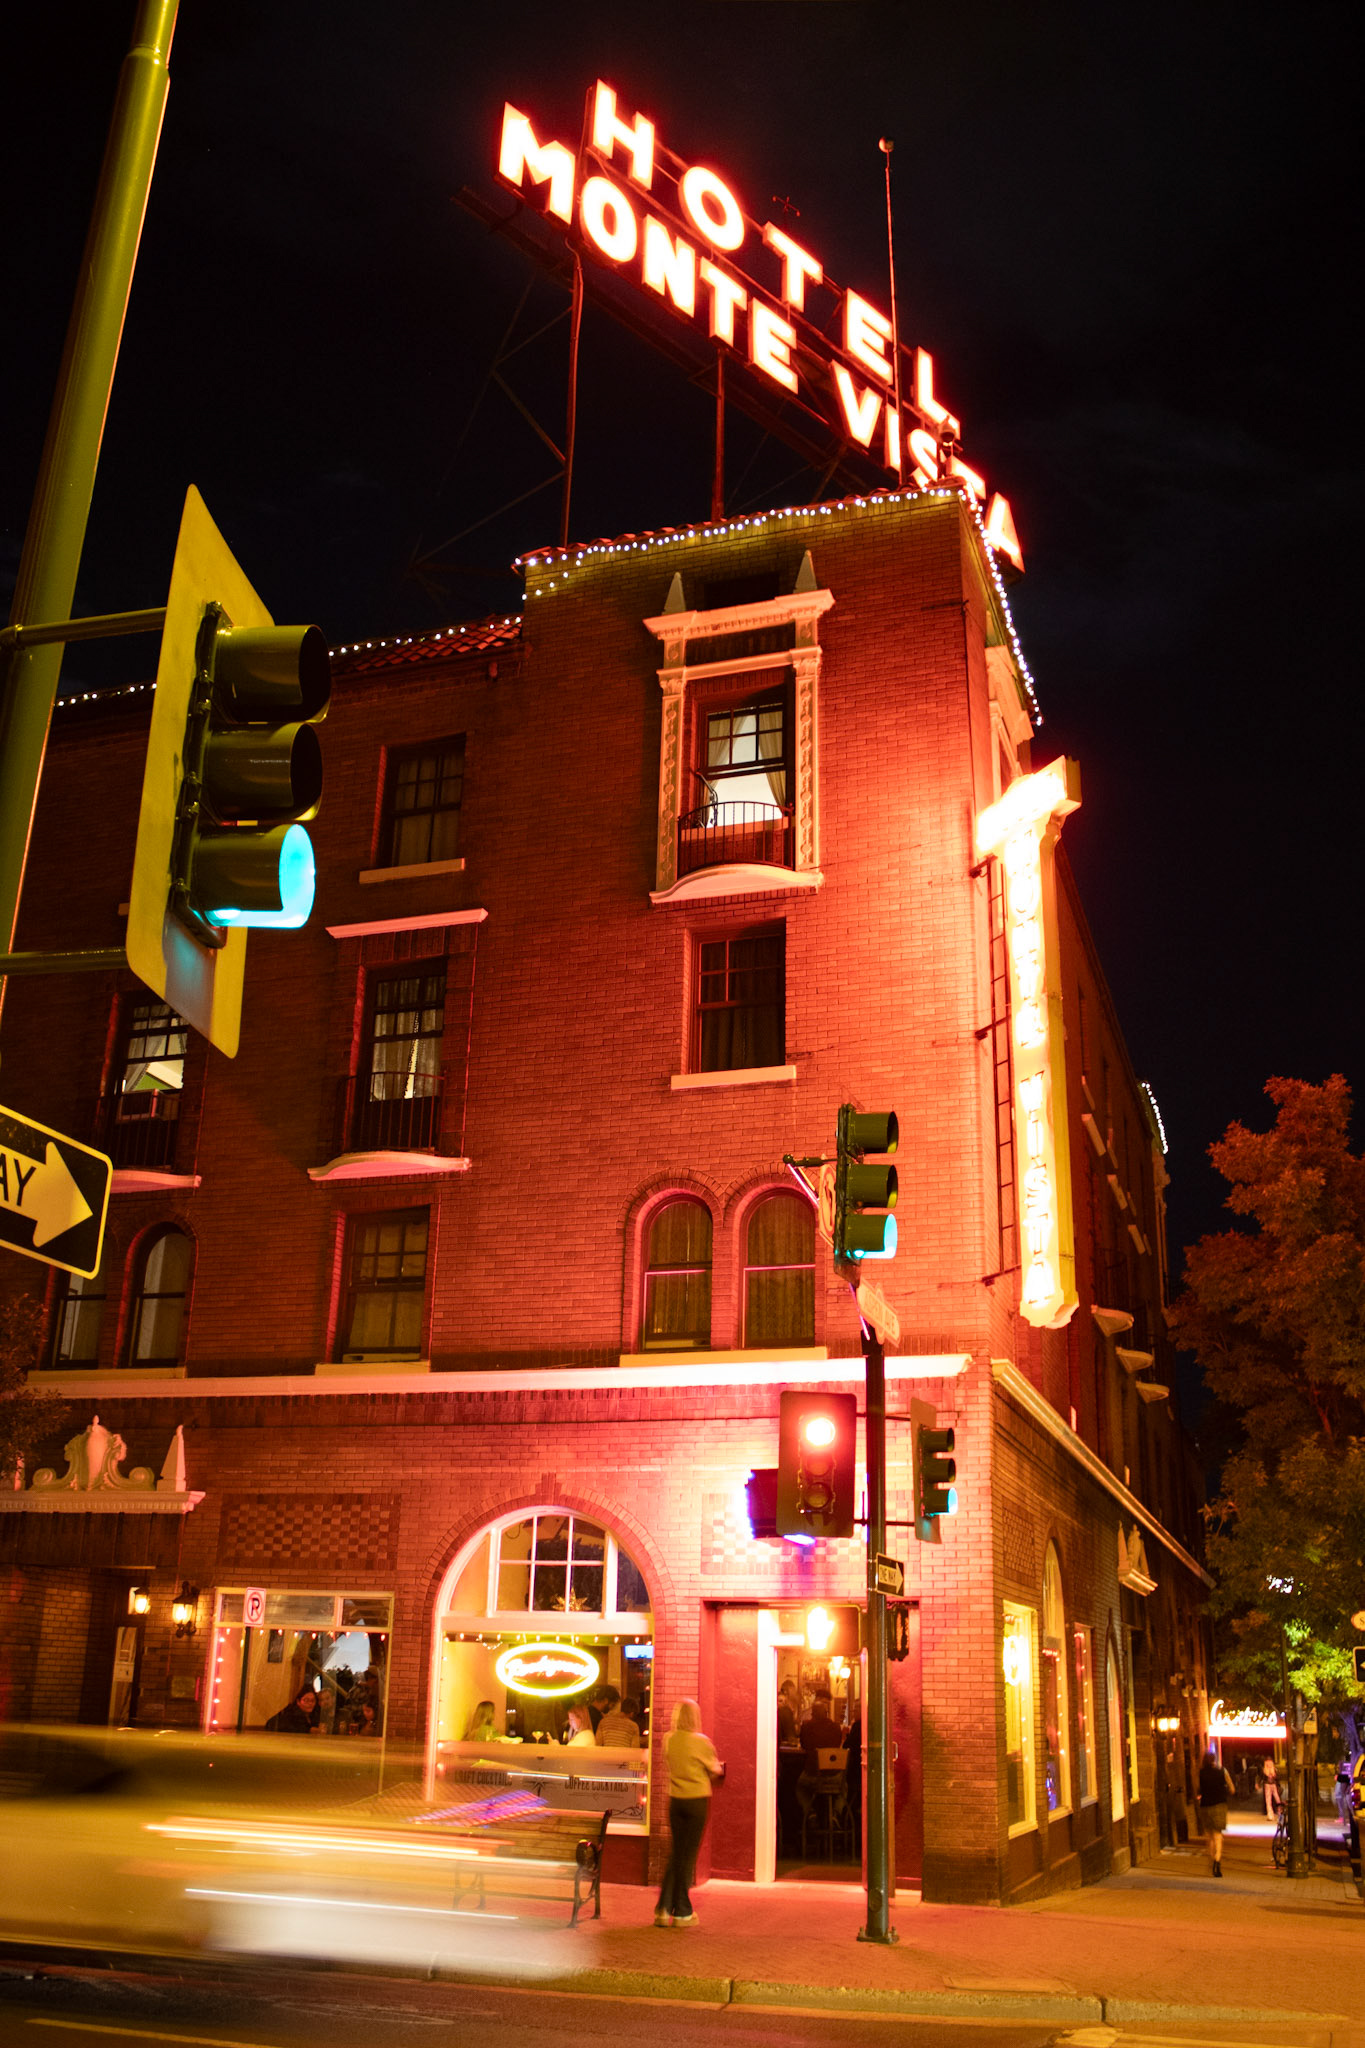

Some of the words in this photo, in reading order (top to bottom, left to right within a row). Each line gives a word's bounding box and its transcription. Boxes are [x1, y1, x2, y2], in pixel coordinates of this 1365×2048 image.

[498, 101, 799, 394] MONTE
[592, 79, 960, 438] HOTEL
[1018, 1072, 1055, 1308] VISTA
[879, 1566, 888, 1582] ONE
[564, 1775, 590, 1791] COFFEE
[591, 1778, 629, 1793] COCKTAILS
